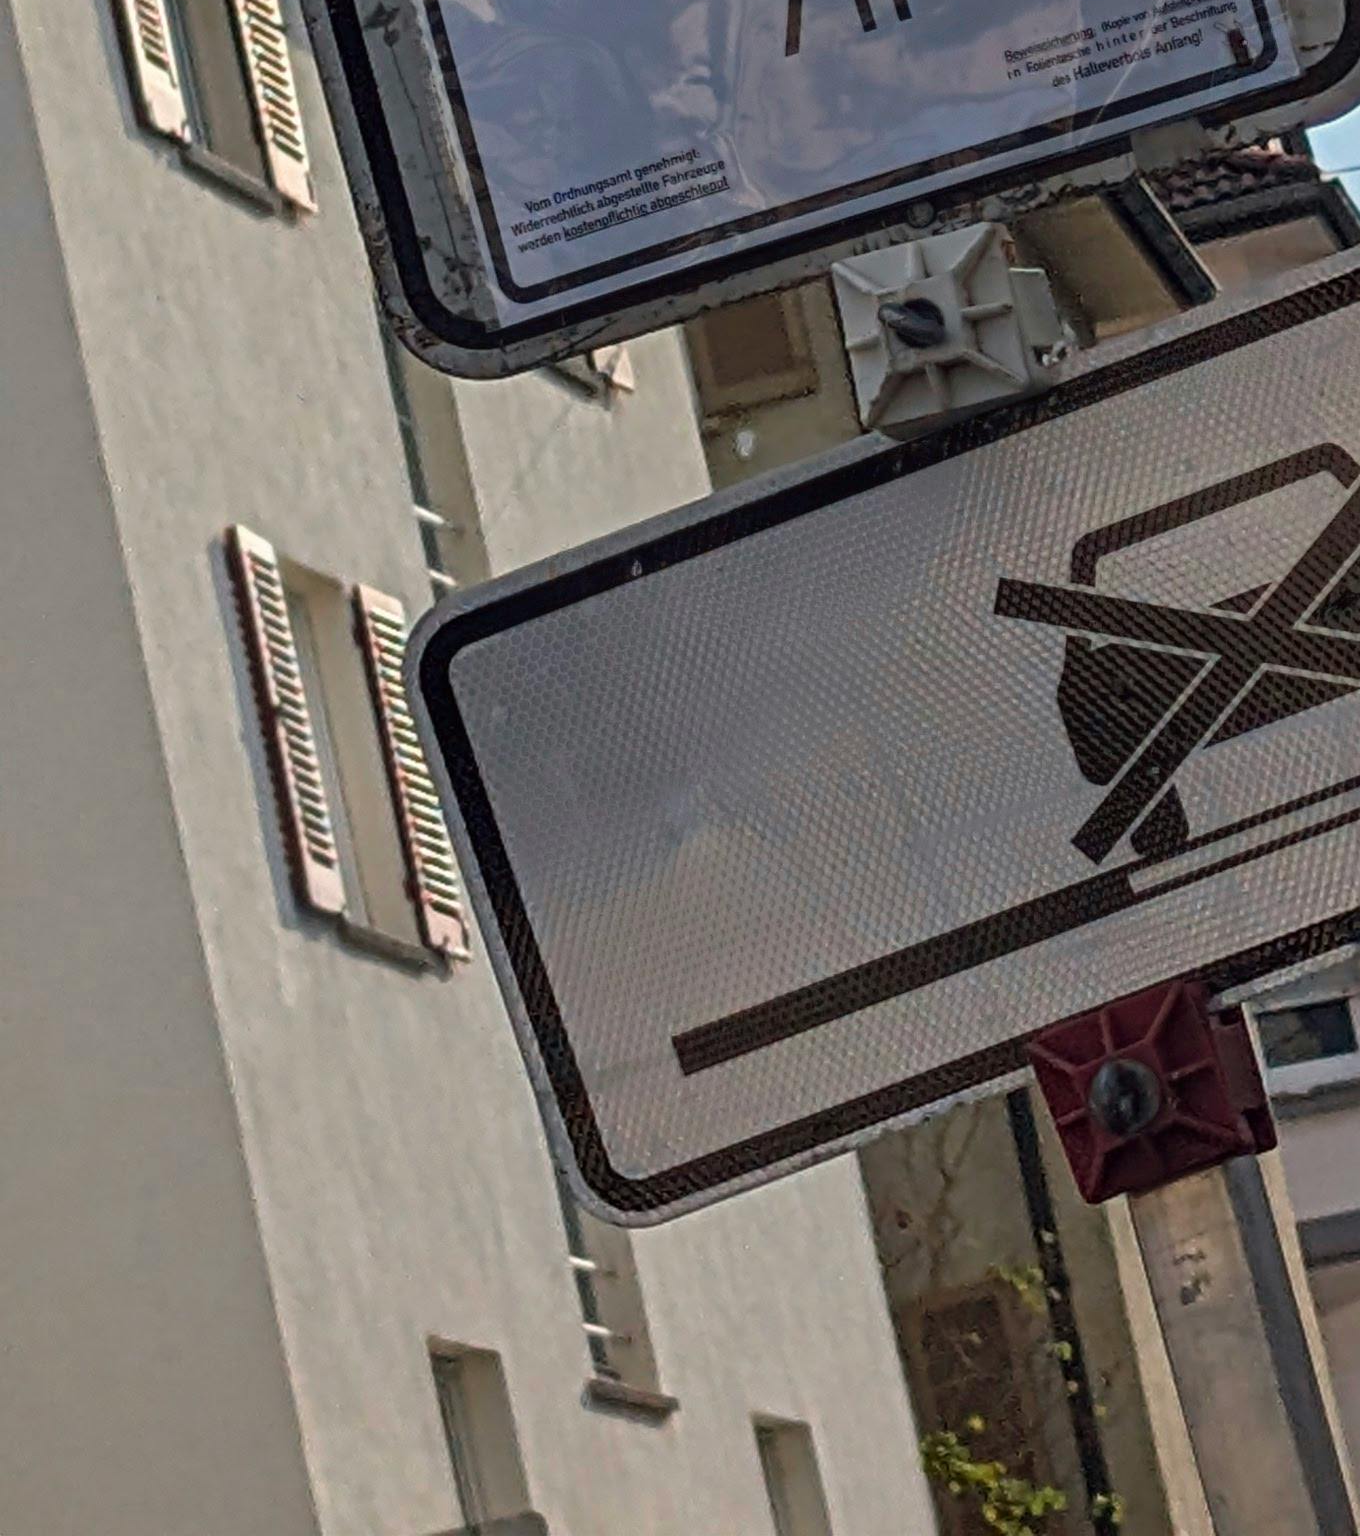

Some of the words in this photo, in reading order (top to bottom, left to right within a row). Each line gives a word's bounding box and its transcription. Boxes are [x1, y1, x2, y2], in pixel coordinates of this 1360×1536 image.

[1169, 0, 1238, 29] Beschriftung
[511, 200, 596, 237] Widerrechtlich
[596, 181, 660, 210] abgestellte
[661, 159, 726, 189] Fahrzeuge
[524, 196, 552, 214] Vom
[553, 168, 632, 204] Ordnungsamt
[518, 232, 561, 253] werden
[562, 202, 650, 240] kostenpflichtig
